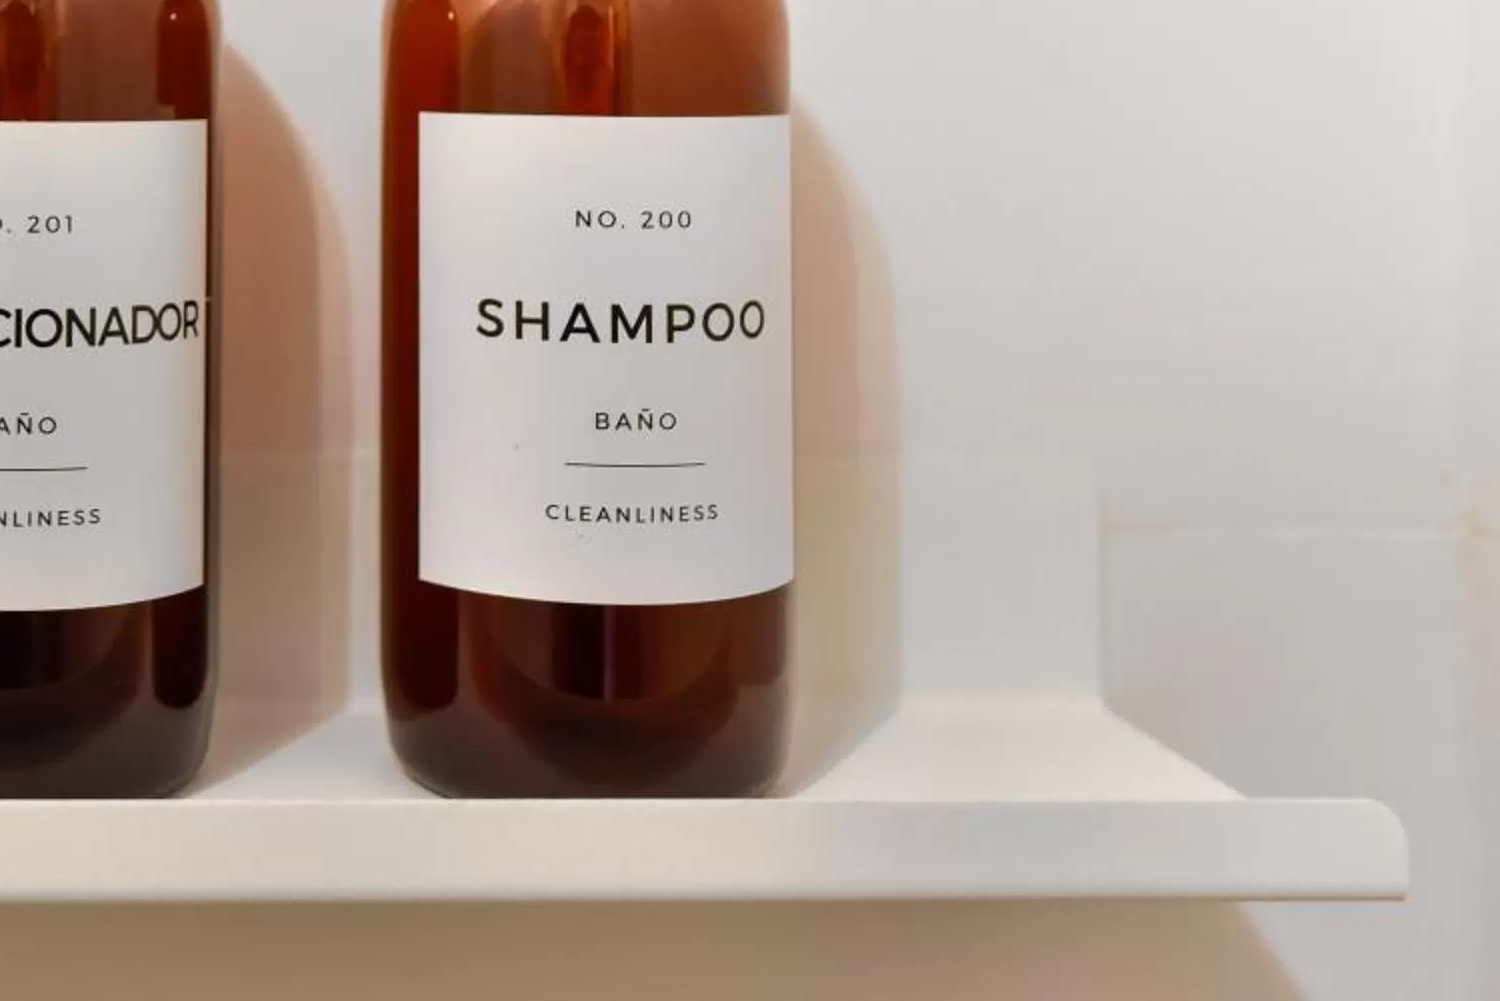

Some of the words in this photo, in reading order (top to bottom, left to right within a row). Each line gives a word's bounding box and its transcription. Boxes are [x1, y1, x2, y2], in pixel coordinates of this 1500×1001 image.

[26, 214, 73, 235] 201
[575, 209, 625, 230] NO.
[640, 210, 692, 230] 200
[475, 297, 766, 345] SHAMPOO
[594, 407, 678, 432] BAÑO
[544, 503, 720, 524] CLEANLINESS
